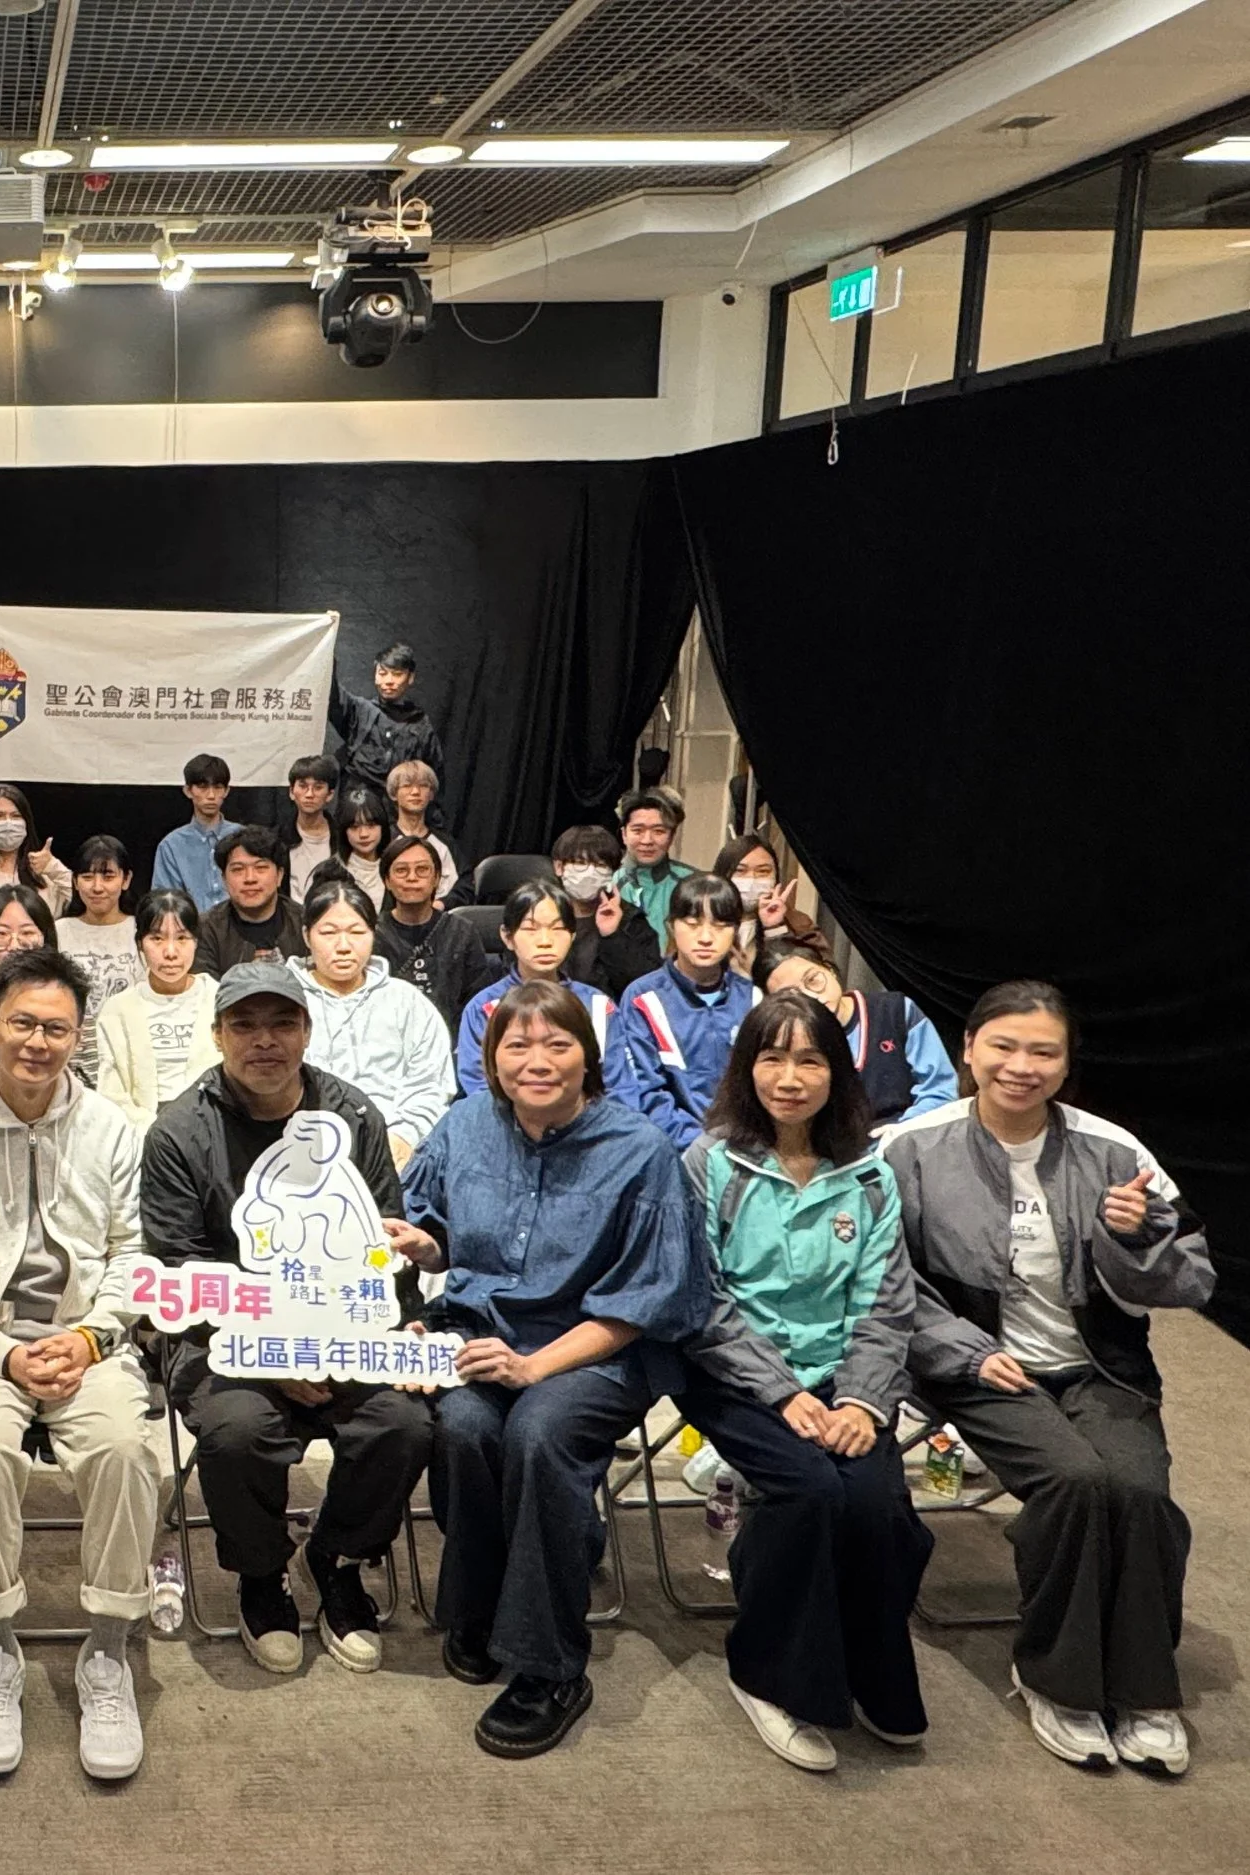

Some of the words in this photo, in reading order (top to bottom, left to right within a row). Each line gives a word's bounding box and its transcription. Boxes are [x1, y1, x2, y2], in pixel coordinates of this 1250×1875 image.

[46, 684, 313, 710] 聖公會澳門社會服務處
[43, 707, 81, 718] Gabinete
[82, 709, 135, 720] Coordenador
[137, 711, 151, 720] dos
[153, 711, 188, 722] Serviços
[190, 711, 218, 721] Sociais
[220, 712, 246, 723] Sheng
[248, 712, 269, 723] Kung
[271, 713, 285, 721] Hui
[287, 713, 313, 722] Macau
[132, 1267, 273, 1322] 25周年
[219, 1334, 456, 1377] 北區青年服務隊
